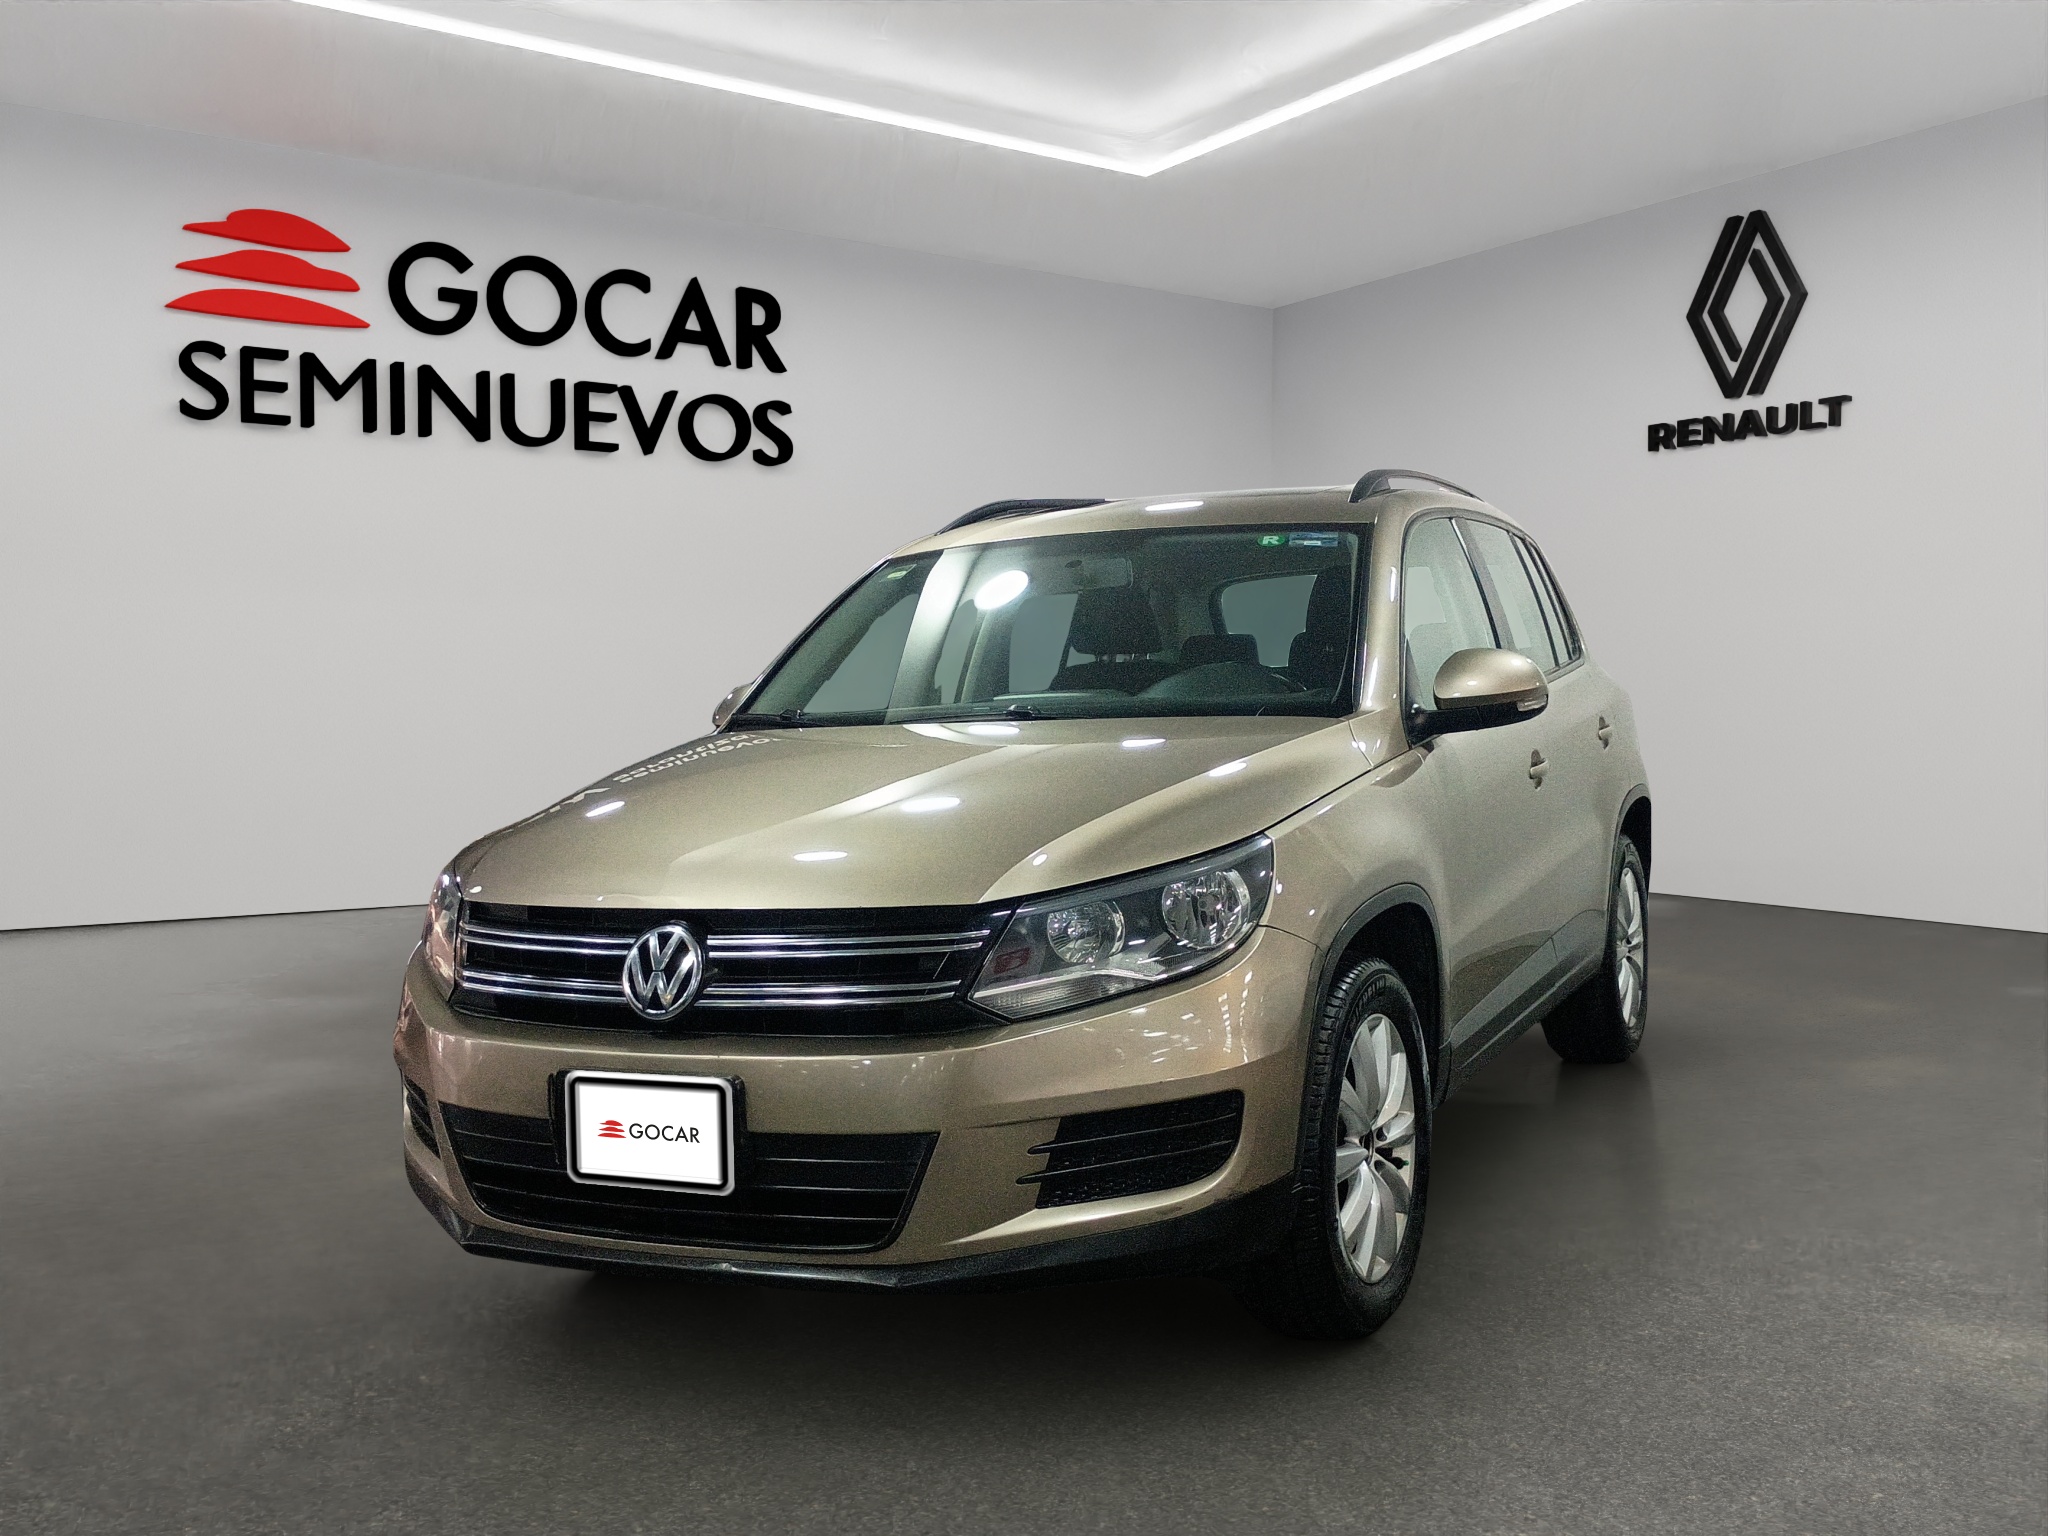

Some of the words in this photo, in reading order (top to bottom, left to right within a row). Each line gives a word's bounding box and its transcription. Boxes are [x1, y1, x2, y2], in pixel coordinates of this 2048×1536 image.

[388, 241, 788, 373] GOCAR
[178, 340, 794, 467] SEMINUEVOS
[1648, 395, 1853, 452] RENAULT
[629, 1123, 700, 1143] GOCAR
